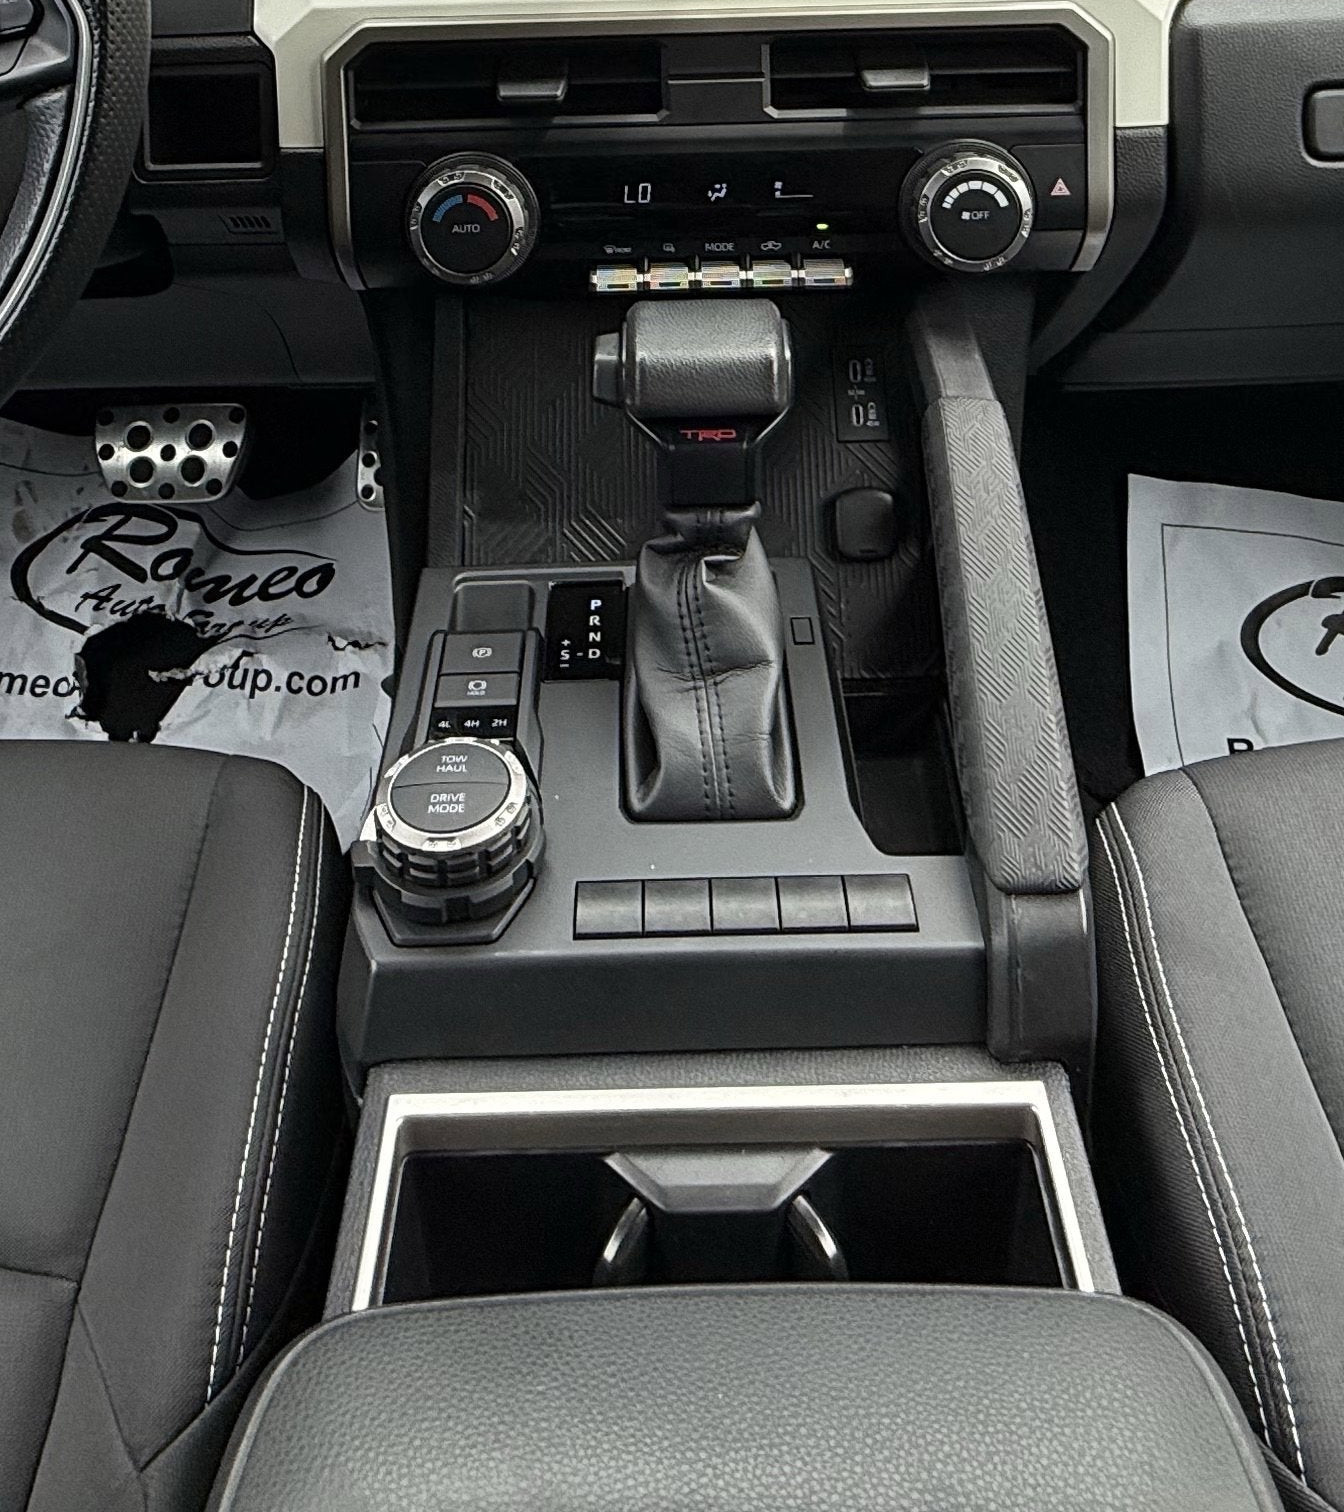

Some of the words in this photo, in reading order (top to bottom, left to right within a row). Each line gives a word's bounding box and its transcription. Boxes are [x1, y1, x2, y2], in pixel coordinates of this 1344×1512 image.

[971, 210, 991, 220] OFF
[451, 223, 481, 234] AUTO
[705, 242, 735, 252] MODE
[812, 240, 831, 250] A/C
[679, 429, 737, 442] TRD
[66, 505, 337, 607] Romeo
[590, 599, 602, 611] P
[589, 615, 601, 626] R
[588, 631, 601, 643] N
[559, 649, 570, 661] S
[588, 648, 601, 659] D
[438, 720, 452, 729] 4L
[463, 719, 480, 728] 4H
[491, 718, 508, 727] 2H
[440, 755, 469, 763] TOW
[436, 764, 468, 773] HAUL
[430, 792, 466, 802] DRIVE
[427, 803, 465, 814] MODE
